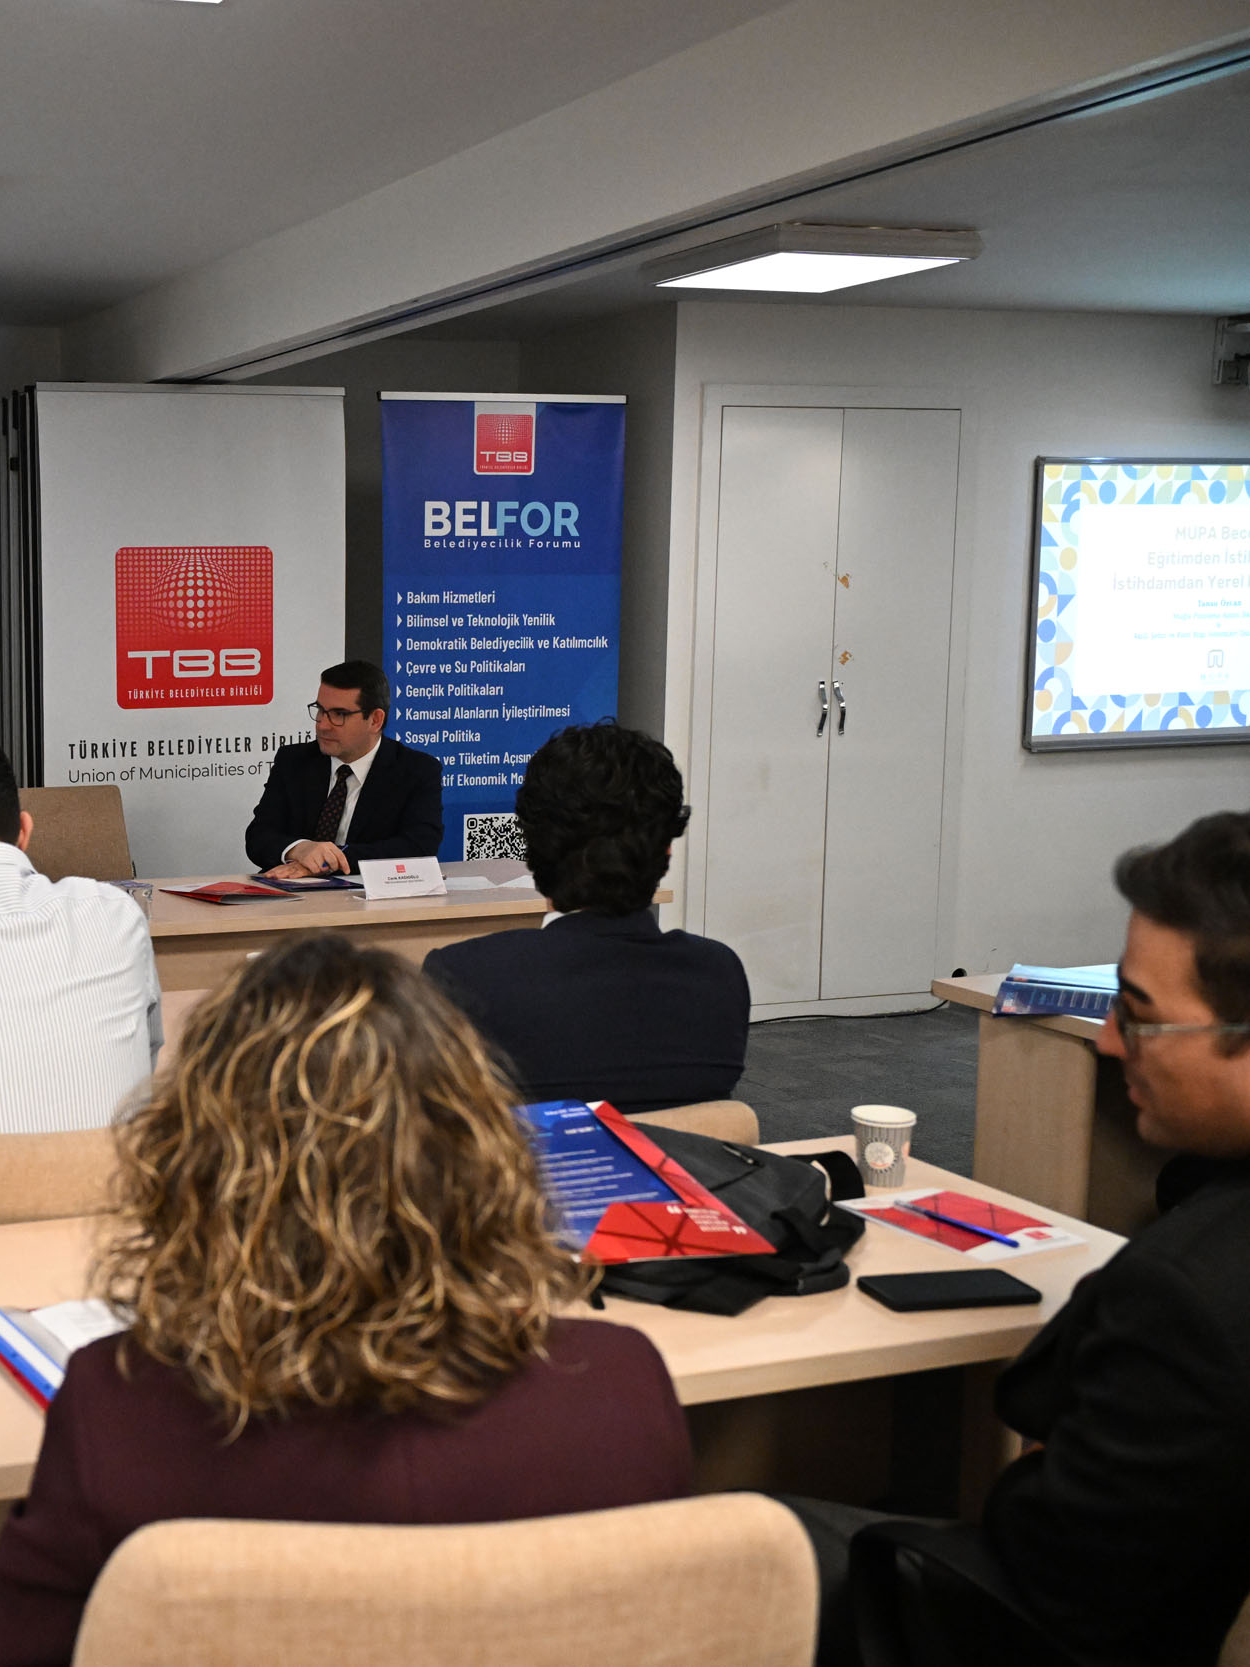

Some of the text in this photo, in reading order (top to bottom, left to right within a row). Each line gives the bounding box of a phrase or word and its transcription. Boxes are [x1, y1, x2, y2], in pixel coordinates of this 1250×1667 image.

[480, 451, 528, 463] TBB
[424, 500, 580, 537] BELFOR
[1174, 526, 1217, 541] MUPA
[424, 538, 581, 550] Belediyecilik Forumu
[1207, 575, 1244, 589] Yerel
[407, 590, 496, 604] Bakım Hizmetleri
[406, 613, 556, 629] Bilimsel ve Teknolojik Yenilik
[406, 636, 609, 652] Demokratik Belediyecilik ve Katılımcılık
[128, 648, 261, 679] TBB
[406, 660, 526, 677] Çevre ve Su Politikaları
[128, 684, 262, 700] TÜRKİYE BELEDİYELER BİRLİĞİ
[405, 684, 504, 699] Gençlik Politikaları
[405, 703, 570, 721] Kamusal Alanların İyileştirilmesi
[405, 730, 481, 746] Sosyal Politika
[68, 738, 138, 760] TÜRKİYE
[147, 735, 252, 757] BELEDİYELER
[443, 751, 532, 767] ve Tüketim Açısın
[68, 769, 116, 784] Union
[120, 767, 136, 782] of
[140, 762, 245, 781] Municipalities
[248, 760, 264, 775] of
[457, 773, 508, 787] Ekonomik
